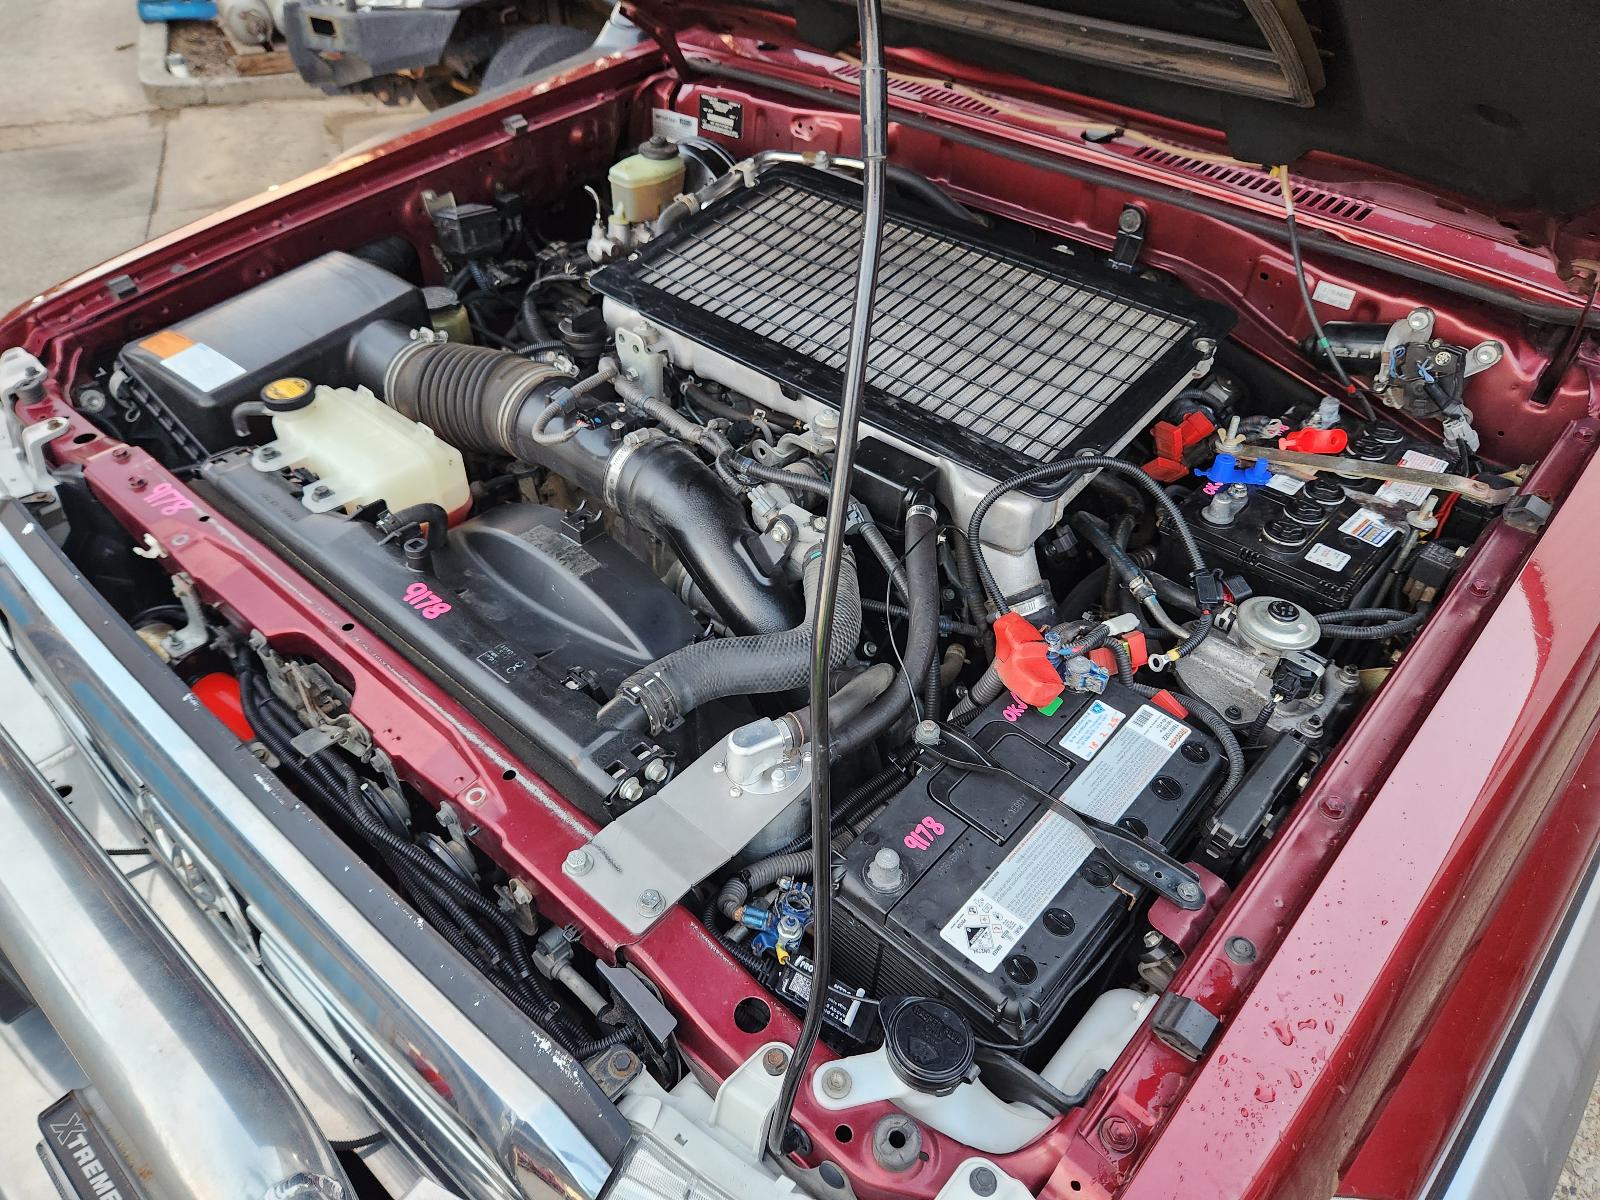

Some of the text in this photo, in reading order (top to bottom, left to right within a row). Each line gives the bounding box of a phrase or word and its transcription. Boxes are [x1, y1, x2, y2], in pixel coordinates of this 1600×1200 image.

[143, 483, 193, 516] 9178
[402, 582, 452, 620] 9178
[903, 816, 945, 851] 9178
[799, 961, 813, 972] PRO
